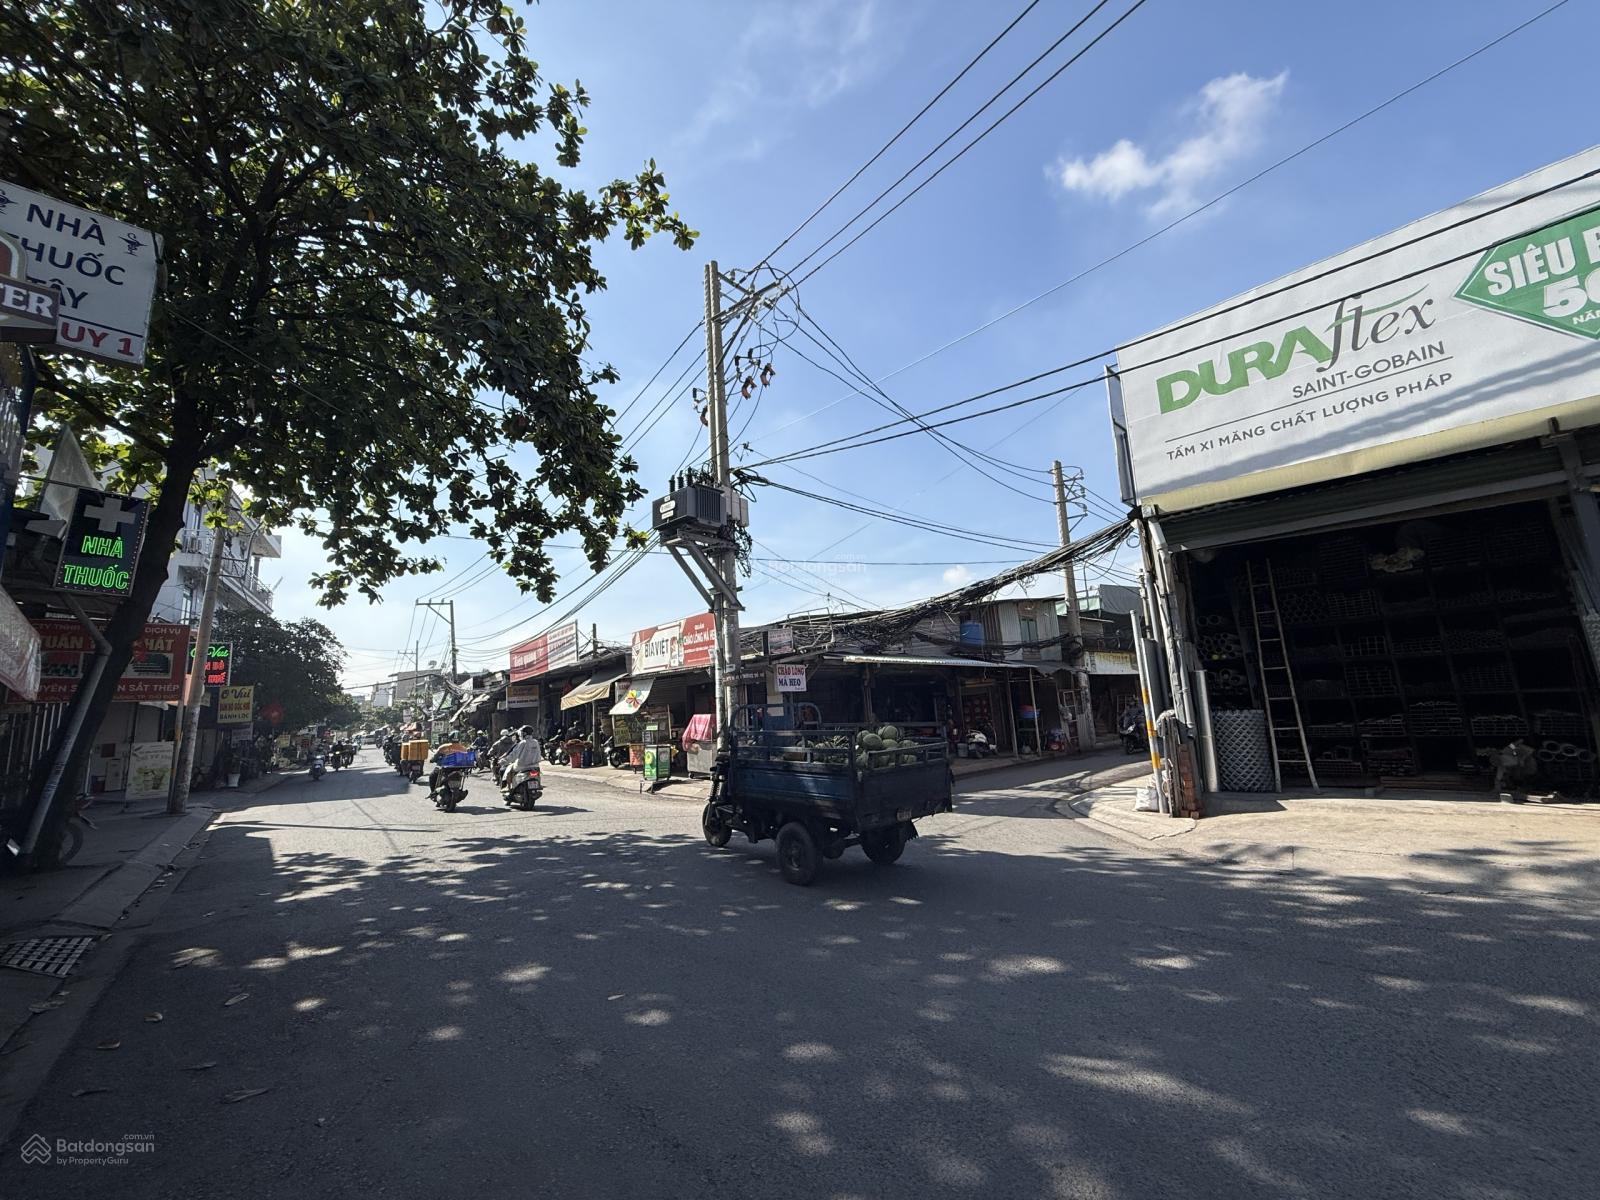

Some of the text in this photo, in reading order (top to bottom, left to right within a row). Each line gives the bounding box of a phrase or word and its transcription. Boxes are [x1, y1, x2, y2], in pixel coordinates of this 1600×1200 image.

[27, 203, 106, 246] NHÀ
[8, 232, 126, 286] HUỐC
[1484, 237, 1576, 296] SIÊU
[0, 283, 53, 318] ER
[26, 276, 88, 309] ÂY
[117, 338, 135, 356] 1
[1292, 340, 1446, 399] SAINT-GOBAIN
[1166, 370, 1453, 462] TẤM XI MĂNG CHẤT LƯỢNG PHÁP
[81, 535, 123, 559] NHÀ
[64, 564, 129, 589] THUỐC
[644, 641, 655, 658] BIA
